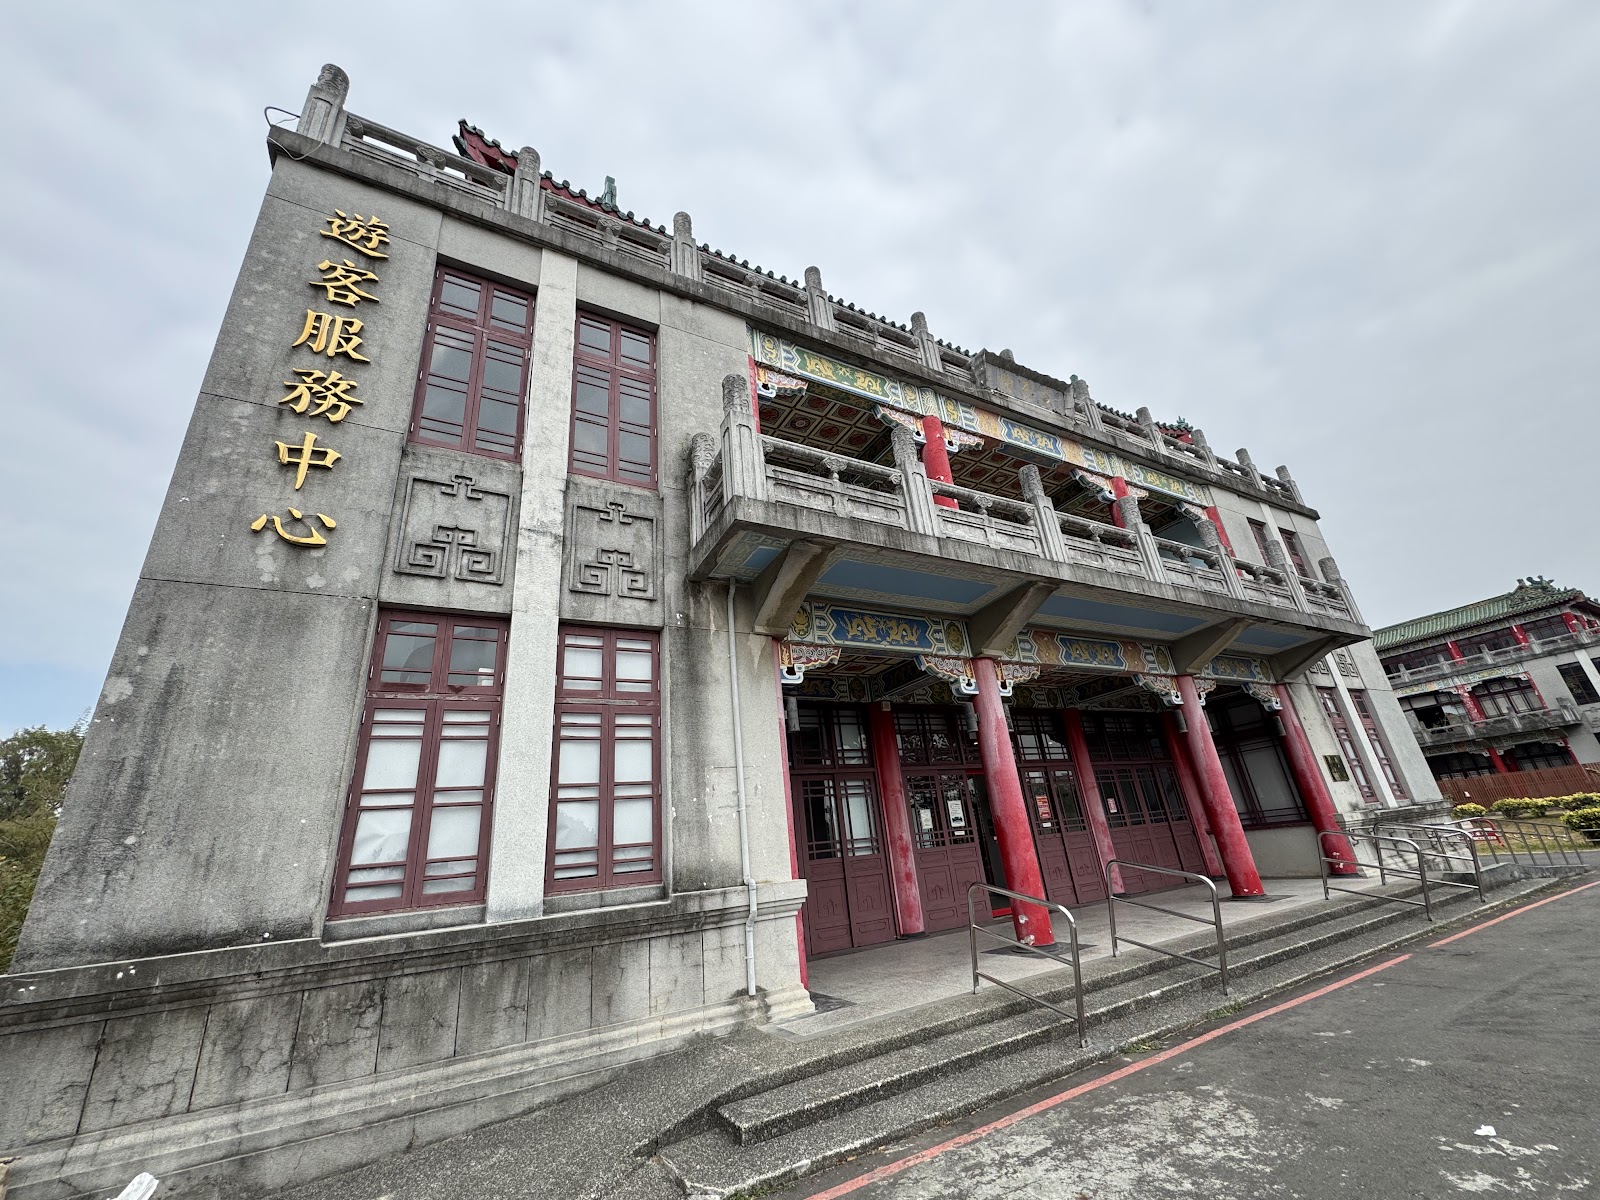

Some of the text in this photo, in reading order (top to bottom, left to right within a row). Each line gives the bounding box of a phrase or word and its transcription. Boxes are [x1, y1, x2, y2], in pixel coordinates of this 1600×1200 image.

[250, 208, 390, 548] 遊客服務中心
